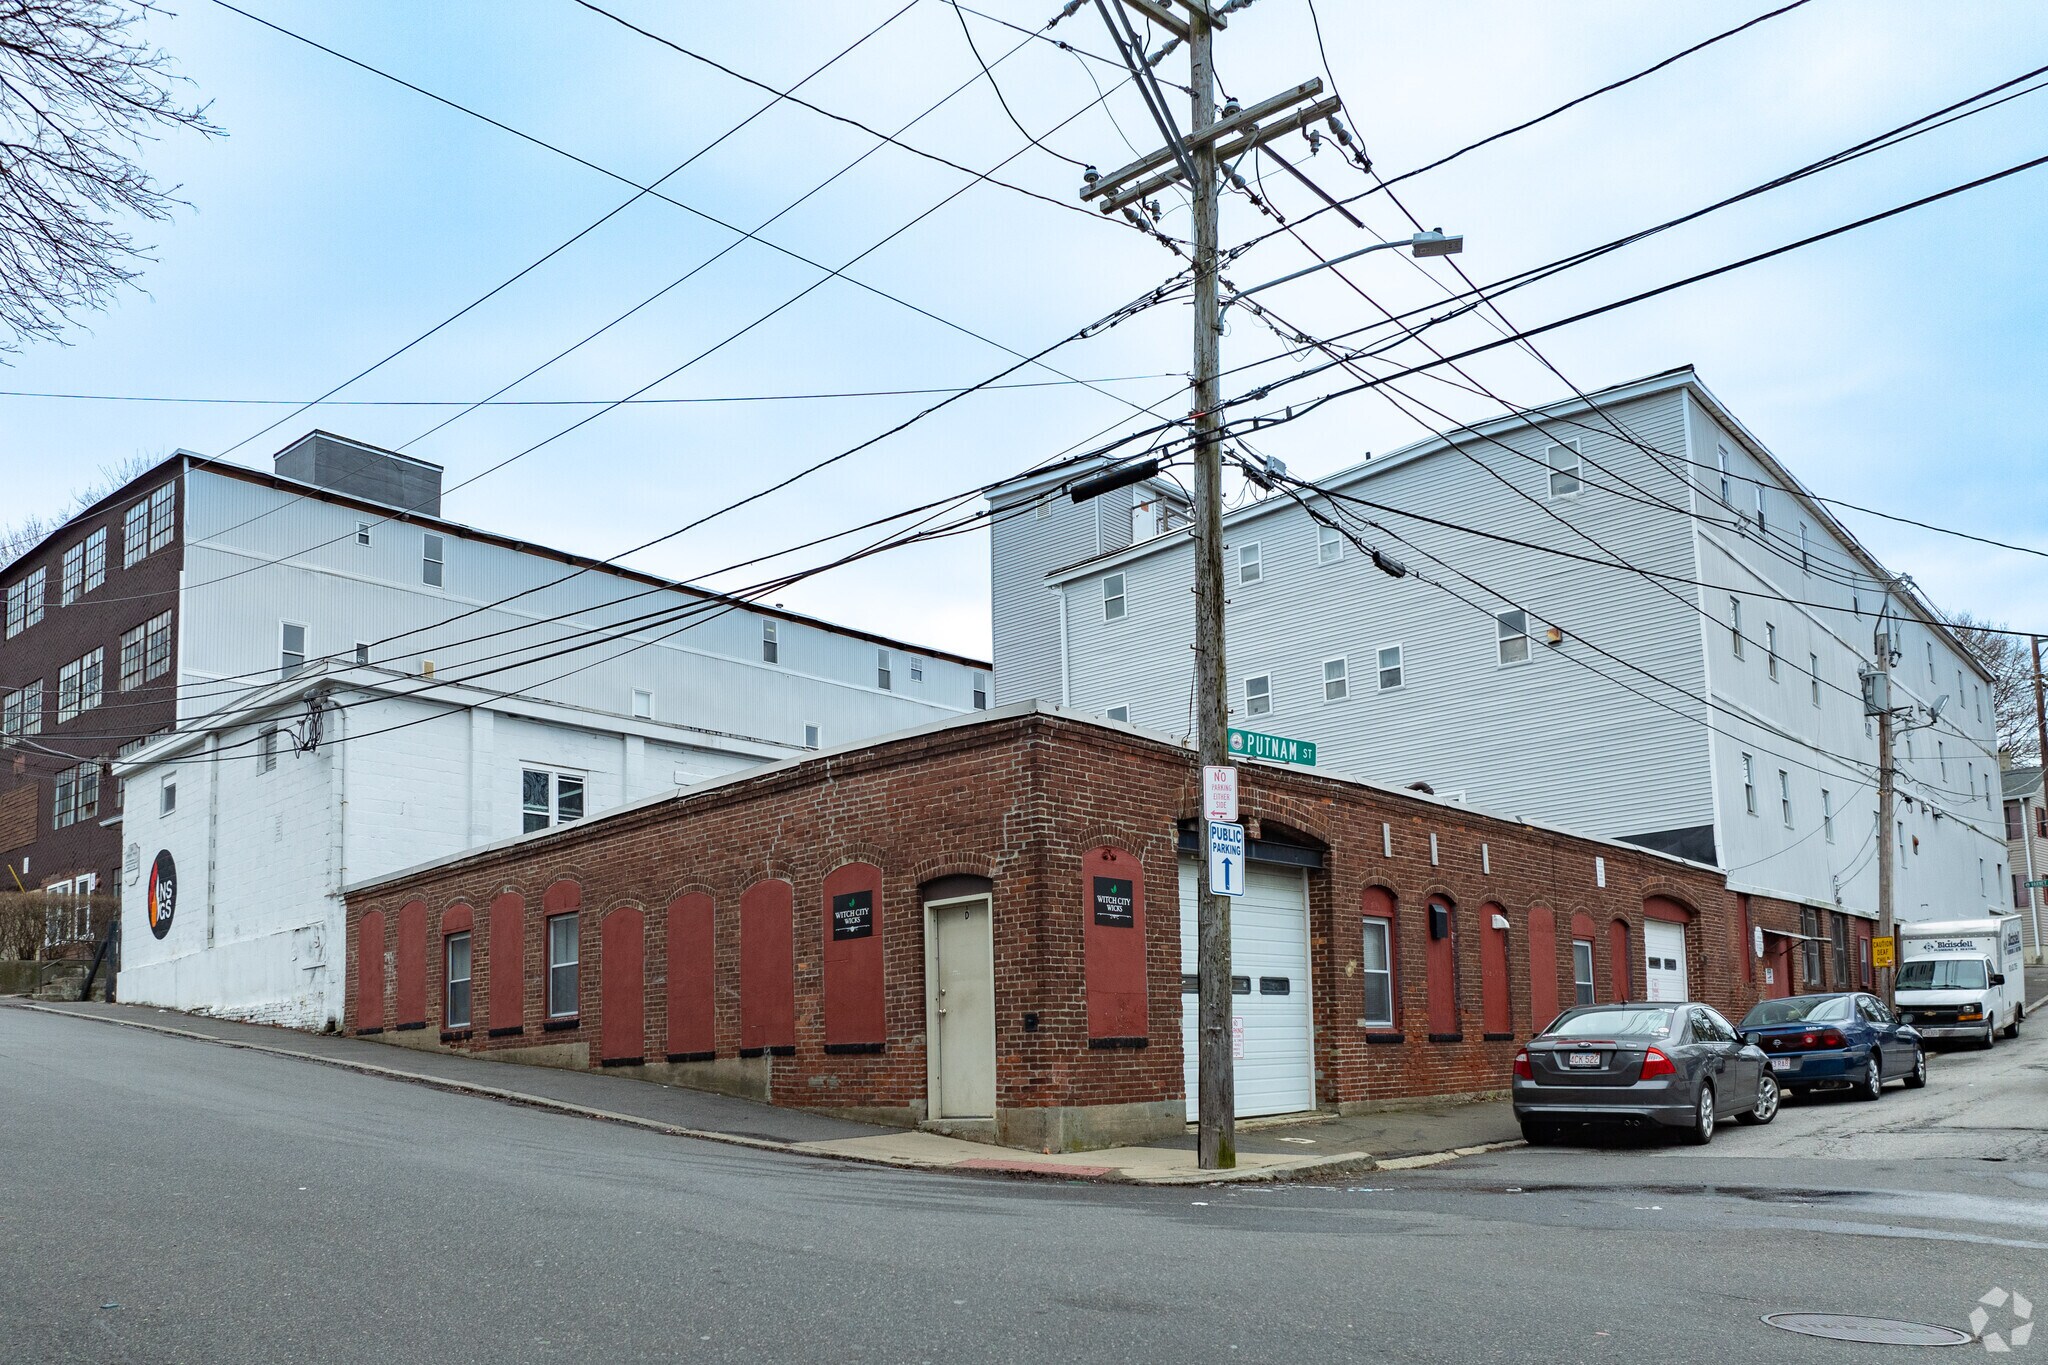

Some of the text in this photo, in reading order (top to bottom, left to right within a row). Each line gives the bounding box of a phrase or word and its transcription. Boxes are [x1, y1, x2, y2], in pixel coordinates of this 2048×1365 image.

[1247, 734, 1312, 760] PUTNAM ST
[1214, 772, 1227, 782] NO
[1211, 784, 1232, 792] PARKING
[1211, 826, 1242, 843] PUBLIC
[1213, 842, 1241, 856] PARKING
[1096, 895, 1131, 906] WITCH CITY
[835, 907, 869, 919] WITCH CITY
[1106, 904, 1123, 912] WICKS
[1873, 940, 1893, 948] CAUTION
[1937, 940, 1973, 948] Blaisdell
[1585, 1055, 1599, 1064] 522
